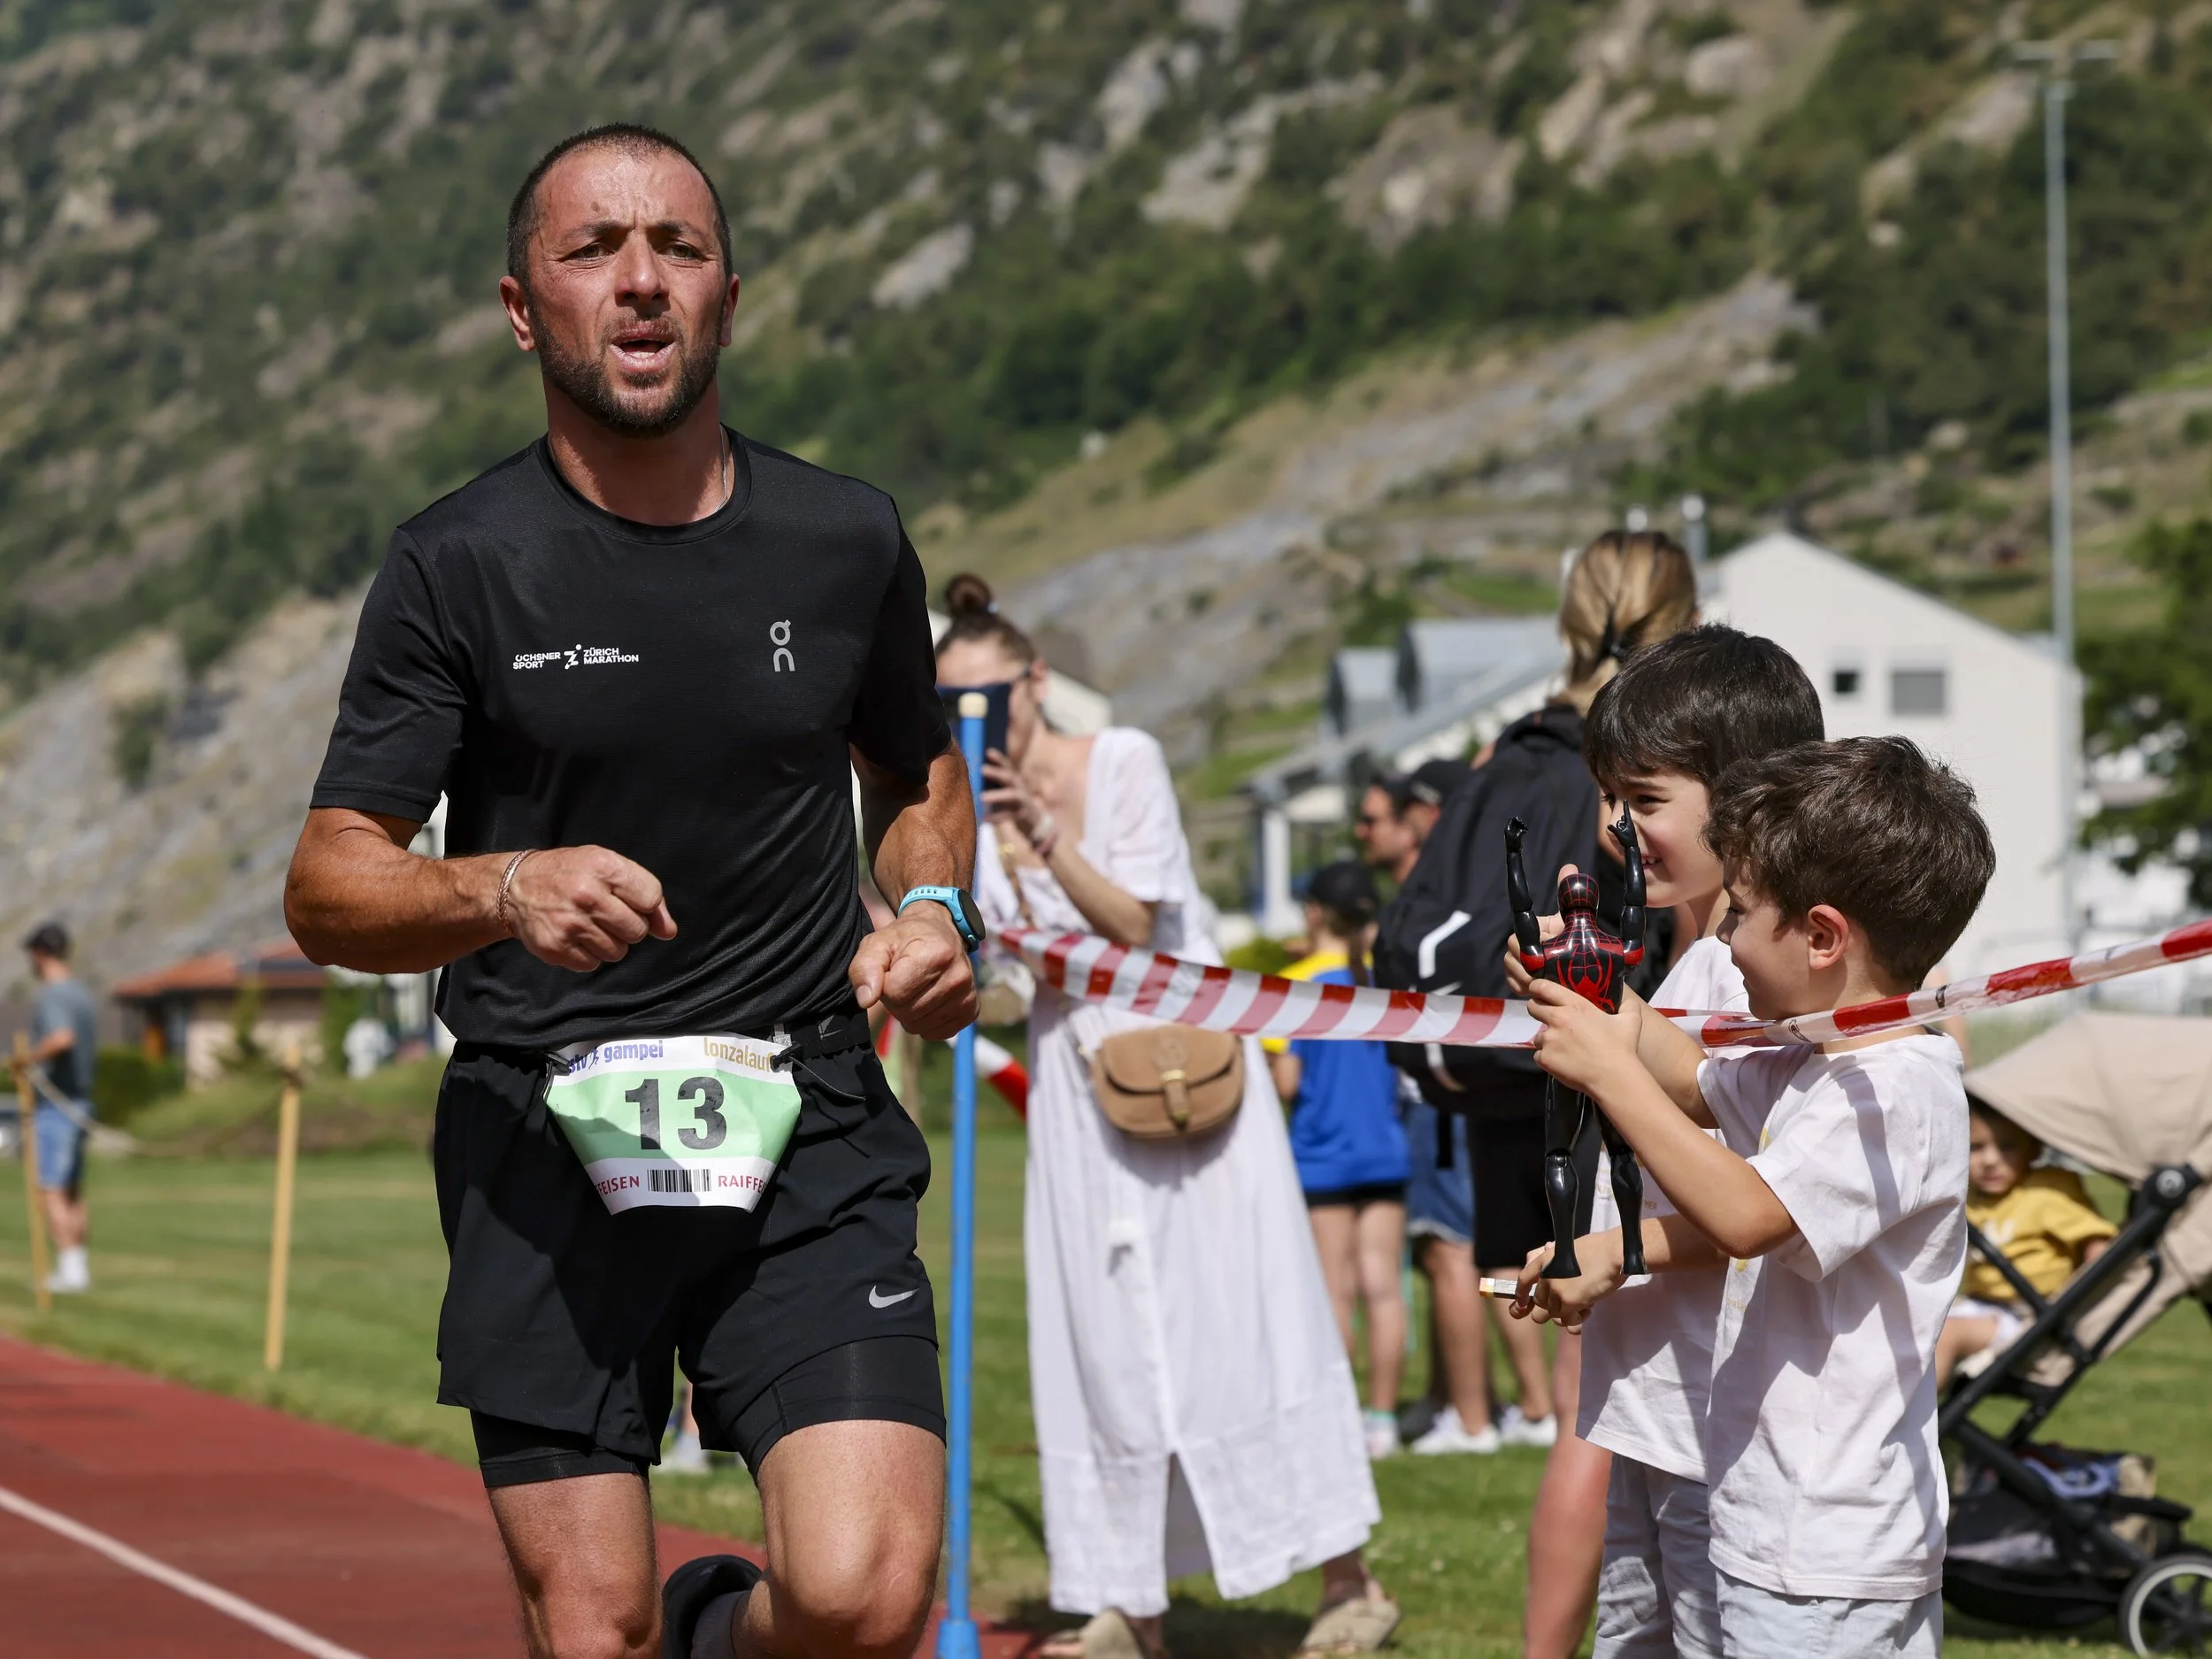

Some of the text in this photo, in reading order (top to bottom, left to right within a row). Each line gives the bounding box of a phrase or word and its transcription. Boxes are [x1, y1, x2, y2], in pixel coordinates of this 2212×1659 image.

[583, 647, 619, 657] ZÜRICH
[583, 655, 639, 664] MARATHON
[513, 660, 544, 670] SPORT
[625, 1076, 727, 1150] 13
